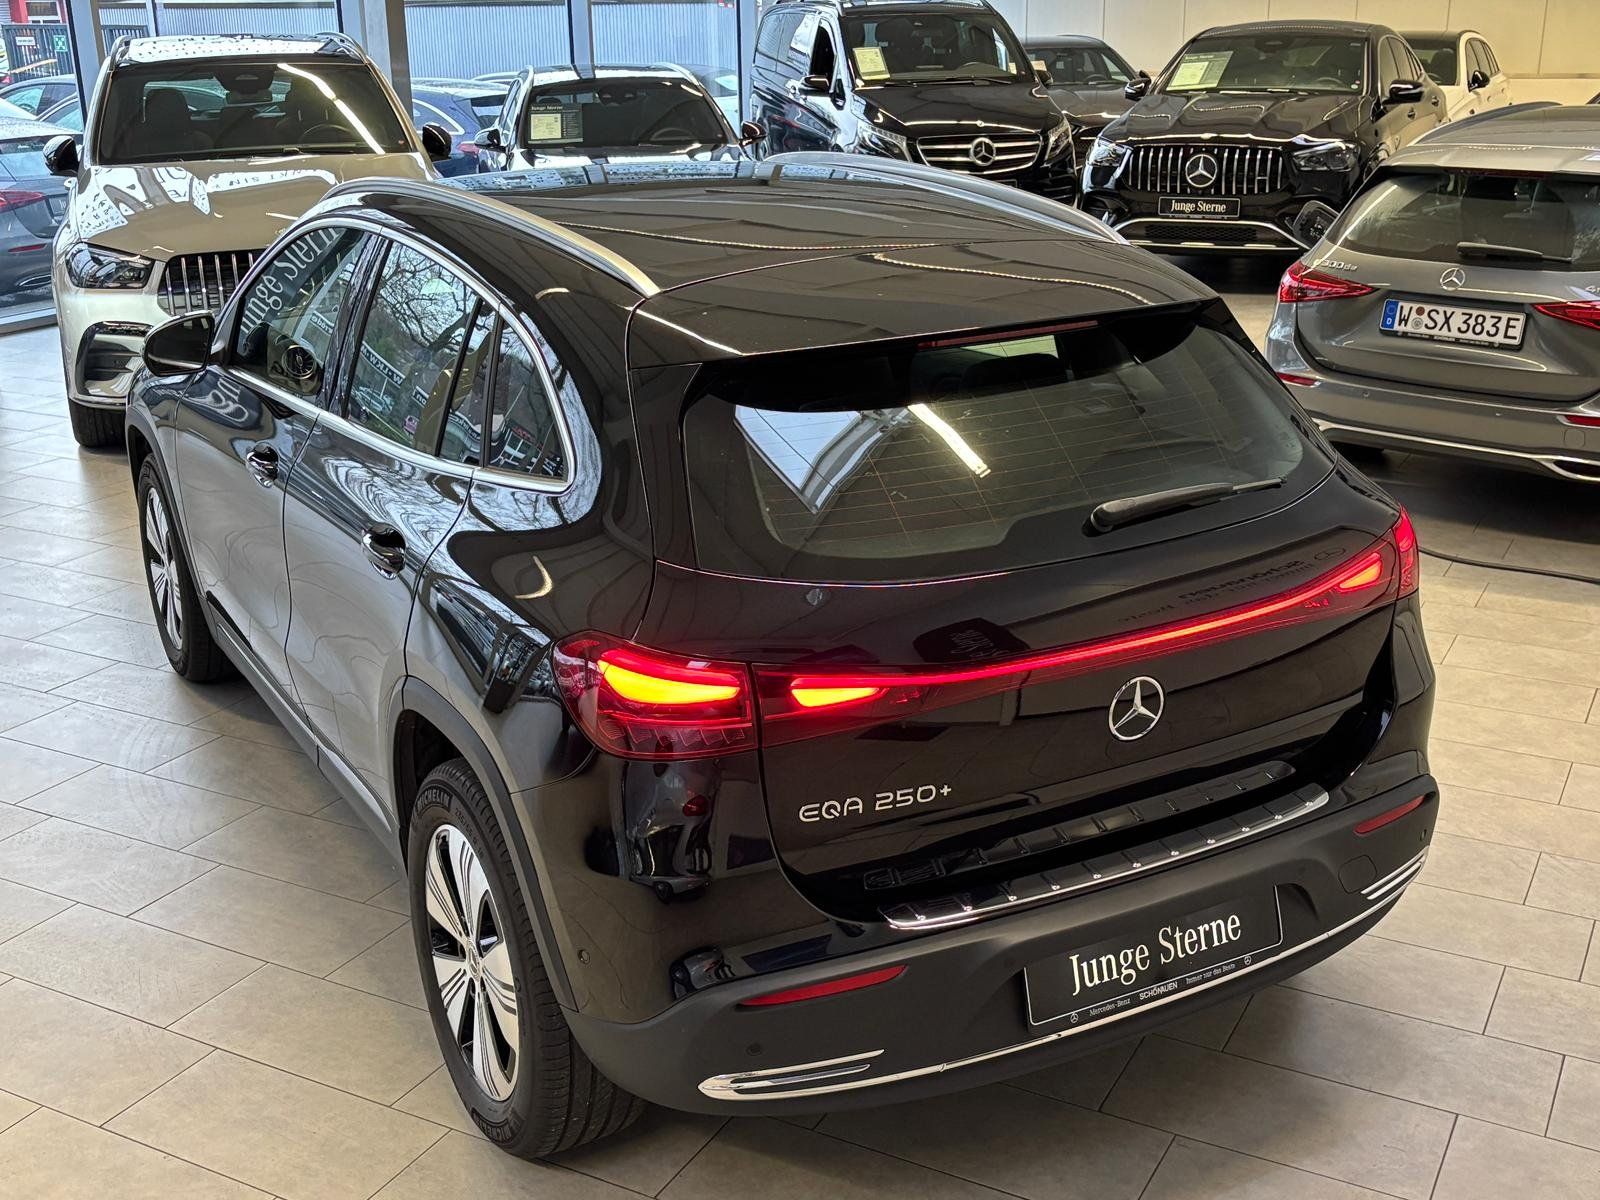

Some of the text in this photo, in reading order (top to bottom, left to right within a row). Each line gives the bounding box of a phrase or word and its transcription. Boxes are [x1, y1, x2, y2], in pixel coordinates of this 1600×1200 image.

[1171, 199, 1227, 213] Junge Sterne
[1386, 317, 1392, 325] D
[1398, 305, 1413, 328] W
[1424, 309, 1455, 333] SX
[1457, 312, 1521, 341] 383E
[798, 784, 952, 823] EQA 250+
[1068, 912, 1242, 997] Junge Sterne
[1088, 997, 1131, 1017] Mercedes-Benz
[1139, 981, 1179, 1000] SCHÖNAUEN
